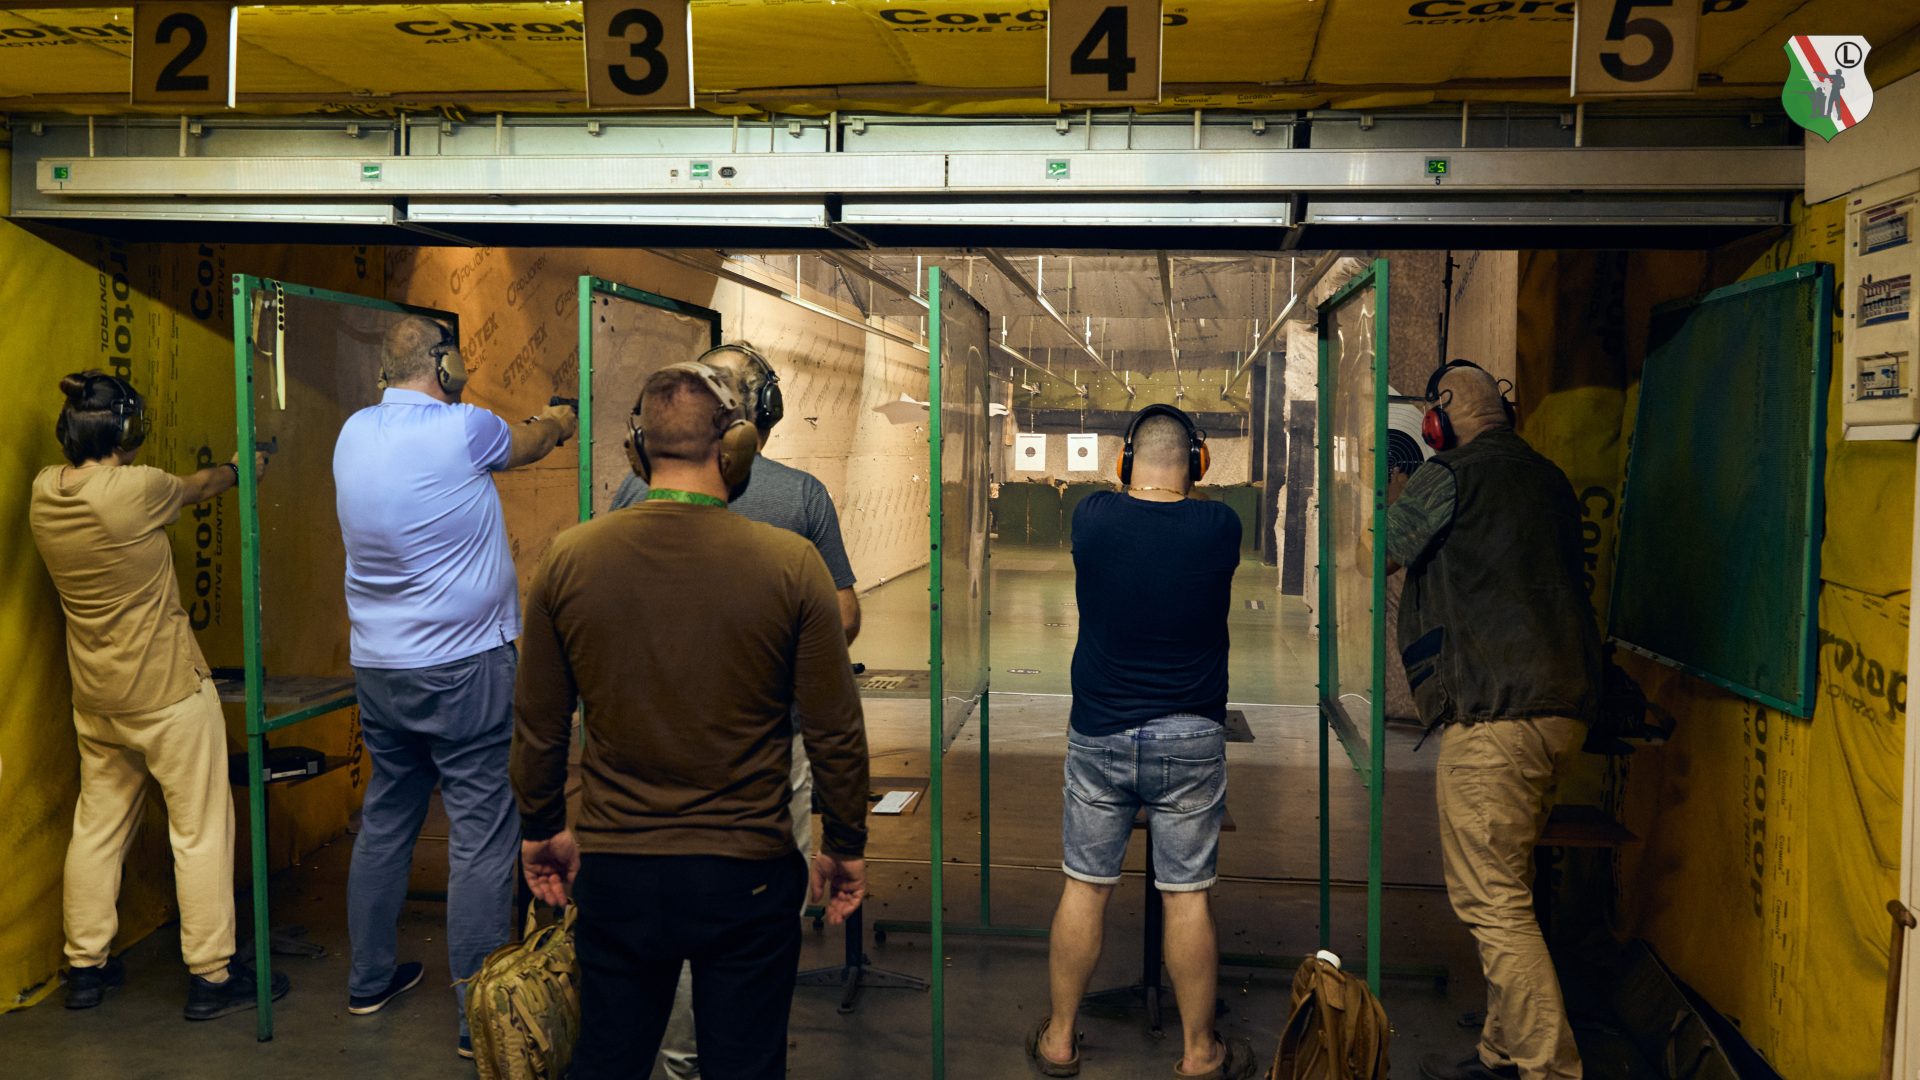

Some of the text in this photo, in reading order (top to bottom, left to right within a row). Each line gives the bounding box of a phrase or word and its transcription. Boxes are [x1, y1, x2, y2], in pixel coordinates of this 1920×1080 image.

[155, 12, 209, 92] 2
[607, 8, 669, 96] 3
[1070, 6, 1136, 92] 4
[1600, 0, 1674, 82] 5
[189, 444, 217, 629] Corotp
[1749, 706, 1767, 919] orotop
